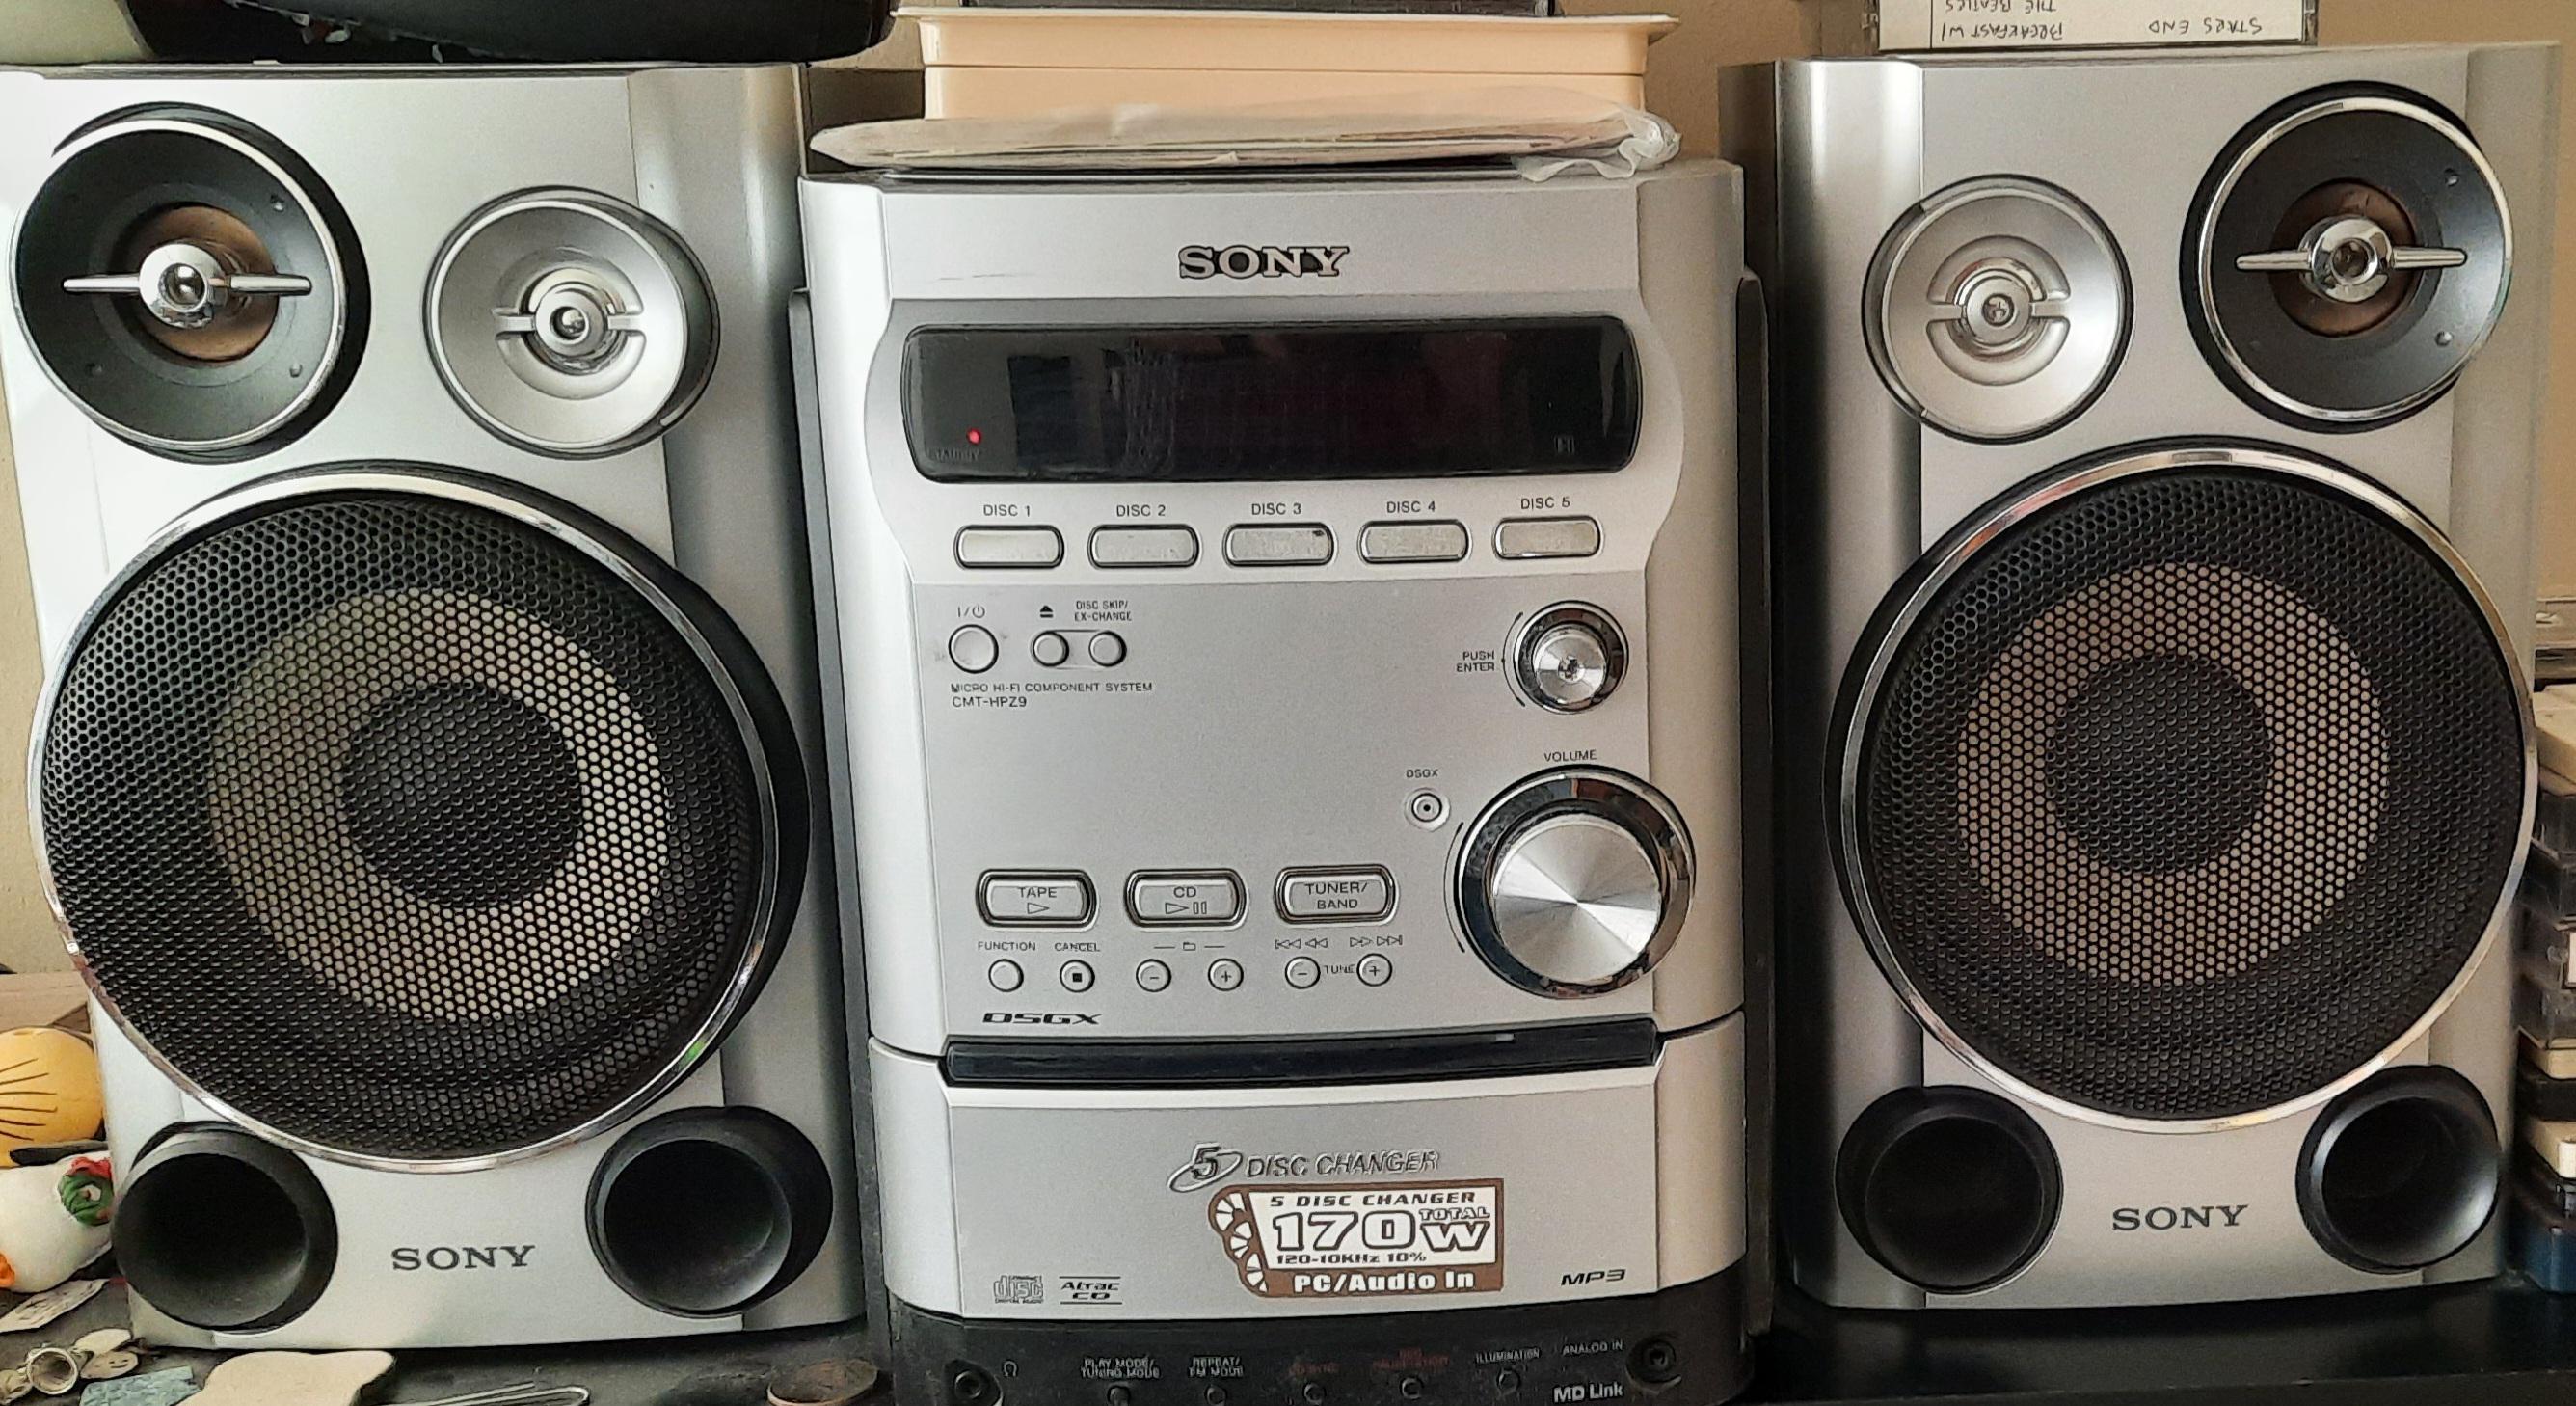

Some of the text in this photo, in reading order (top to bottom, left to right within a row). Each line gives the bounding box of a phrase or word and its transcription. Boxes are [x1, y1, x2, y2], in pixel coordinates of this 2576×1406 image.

[1971, 22, 2063, 41] BREAKFAST
[2149, 17, 2263, 35] STARS END
[1178, 244, 1350, 280] SONY
[1251, 502, 1301, 516] DISC 3
[1386, 500, 1436, 514] DISC 4
[1520, 496, 1570, 510] DISC 5
[983, 504, 1031, 517] DISC 1
[1116, 504, 1166, 517] DISC 2
[1076, 600, 1129, 609] DISC SKIP/
[1074, 611, 1132, 622] EX-CHANGE
[1462, 650, 1495, 661] PUSH
[1456, 662, 1495, 673] ENTER
[951, 682, 1152, 693] MICRO HI-FI COMPONENT SYSTEM
[952, 696, 1027, 708] CMT-HPZ9
[1543, 749, 1597, 763] VOLUME
[1018, 886, 1058, 898] TAPE
[1173, 886, 1196, 898] CD
[1304, 881, 1368, 895] TUNER/
[1317, 899, 1358, 909] BAND
[978, 941, 1036, 951] FUNCTION
[1054, 942, 1100, 952] CANCEL
[1324, 964, 1355, 974] TUNE
[1192, 1142, 1441, 1180] 5 DISC CHANGER
[1270, 1191, 1476, 1207] 5 DISC CHANGER
[1419, 1207, 1491, 1222] TOTAL
[2112, 1204, 2249, 1230] SONY
[1273, 1210, 1491, 1253] 170 W
[390, 1245, 535, 1270] SONY
[1388, 1253, 1427, 1263] 10%
[1294, 1269, 1475, 1293] PC/Audio In
[1561, 1269, 1626, 1285] MP3
[1476, 1348, 1541, 1364] ILLUMINATION
[1554, 1382, 1623, 1402] MD Link
